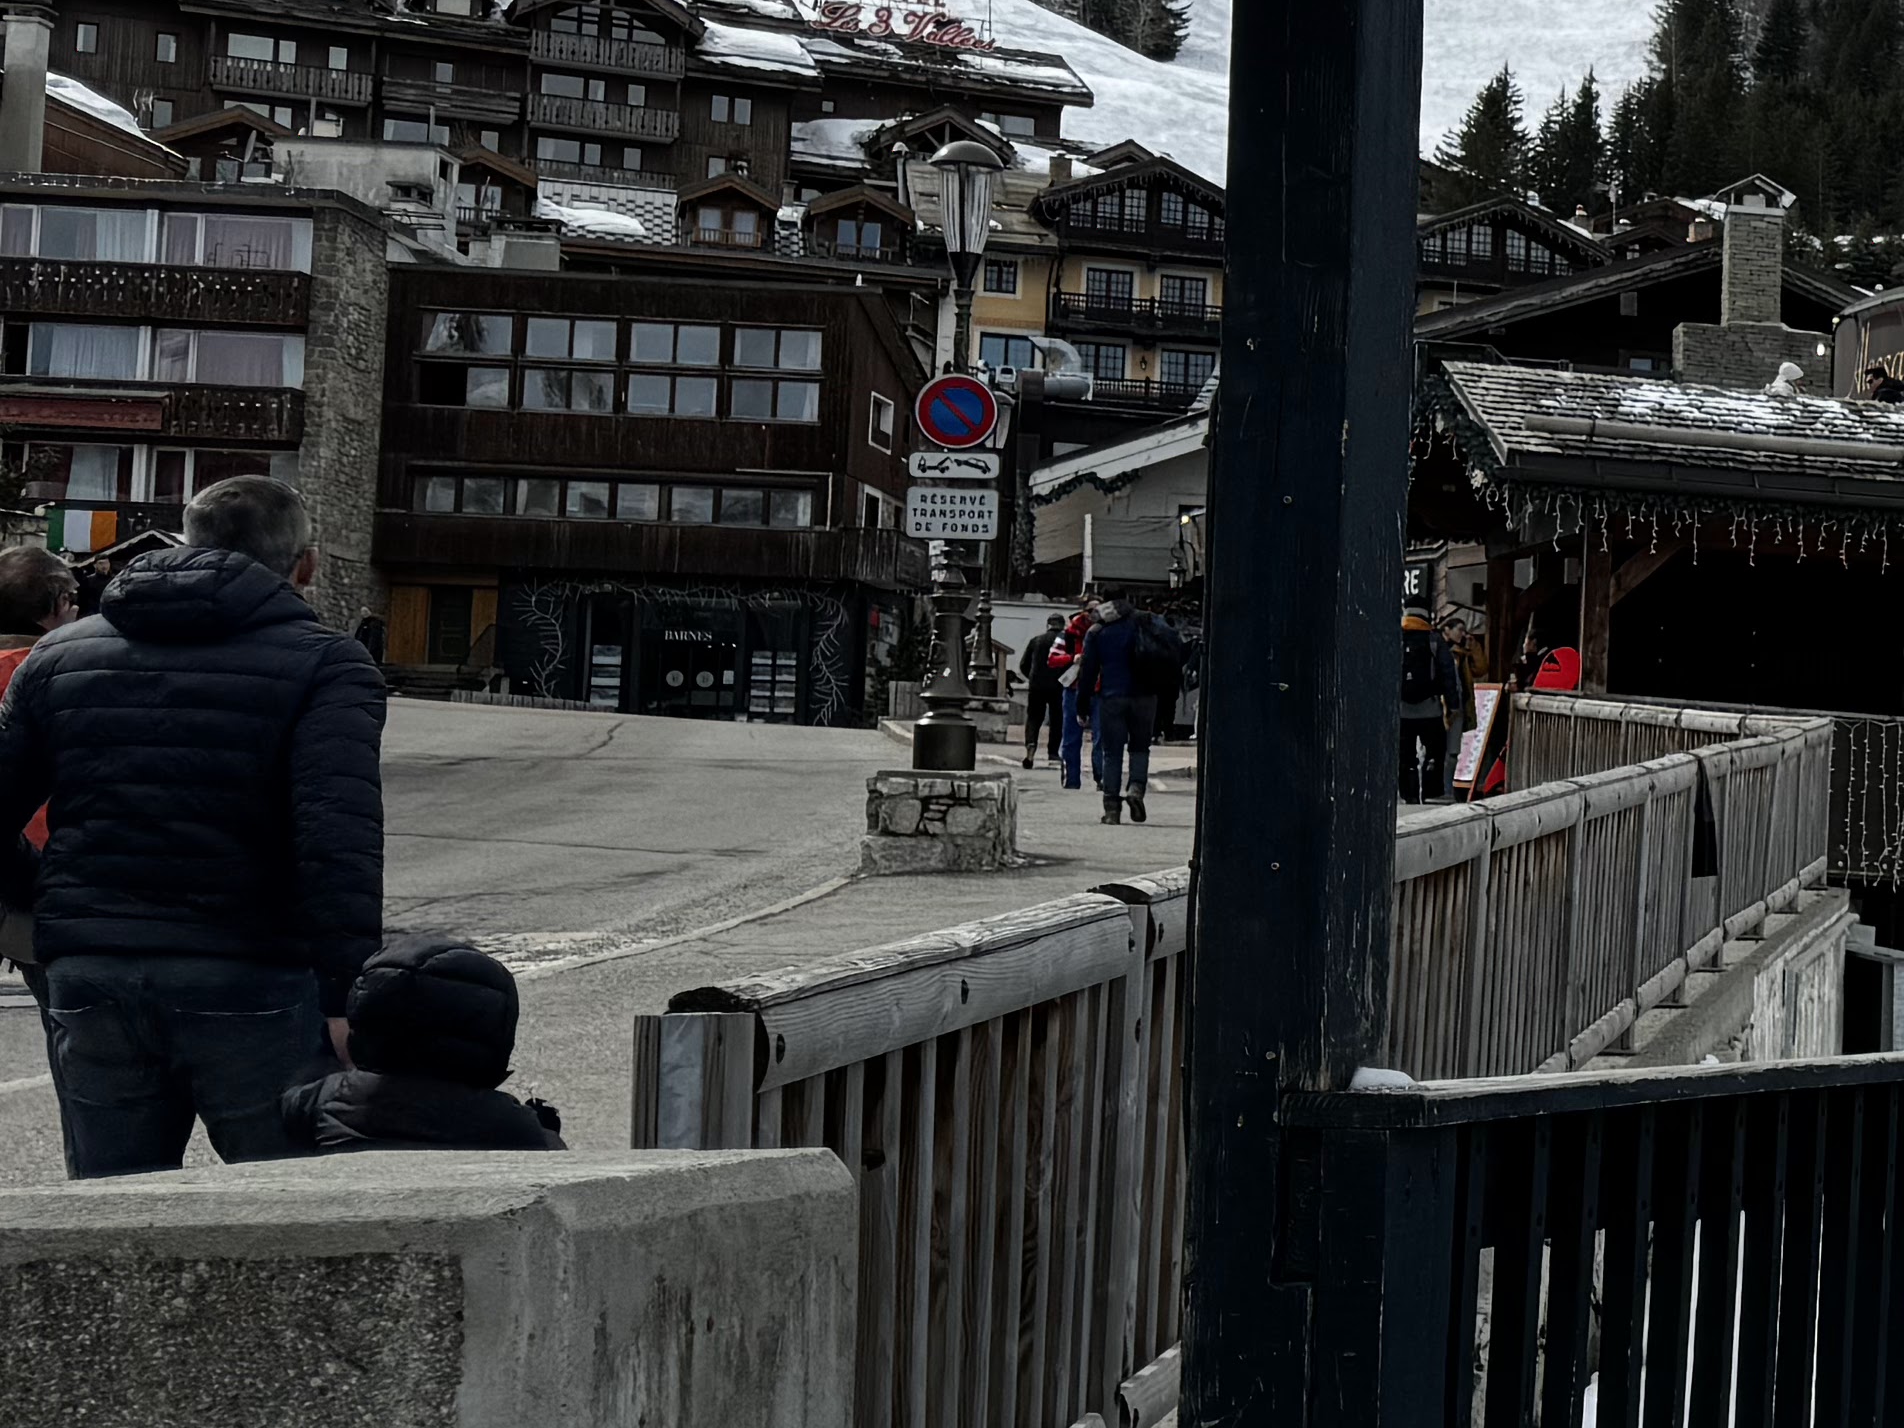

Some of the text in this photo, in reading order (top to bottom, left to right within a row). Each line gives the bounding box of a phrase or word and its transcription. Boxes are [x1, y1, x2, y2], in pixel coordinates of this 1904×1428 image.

[810, 0, 860, 33] Les
[867, 6, 893, 36] 3
[919, 493, 986, 506] RÉSERVÉ
[912, 507, 993, 521] TRANSPORT
[914, 521, 989, 534] DE FONDS
[664, 629, 713, 642] BARNES
